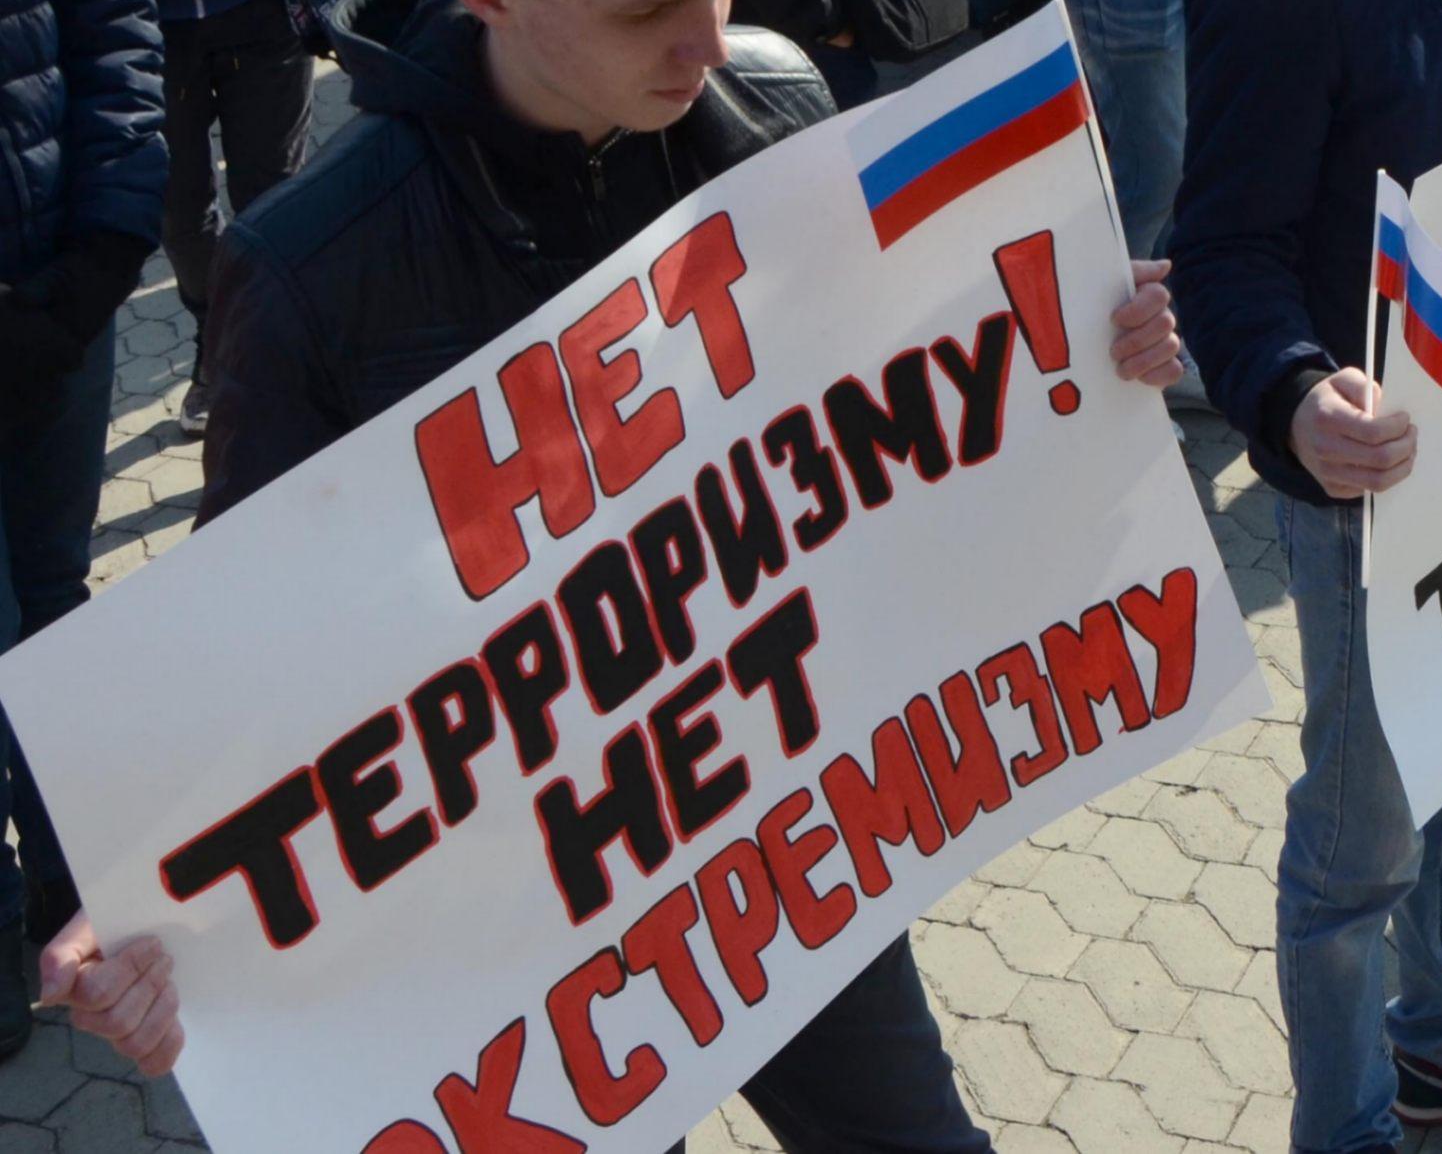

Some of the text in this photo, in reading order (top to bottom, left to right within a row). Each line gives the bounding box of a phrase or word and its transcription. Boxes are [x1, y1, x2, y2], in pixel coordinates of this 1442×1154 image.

[158, 229, 1082, 950] ТЕРРОРИЗМУ!
[413, 210, 758, 602] НЕТ
[360, 567, 1199, 1154] КСТРЕМИЗМУ
[533, 586, 820, 927] НЕТ
